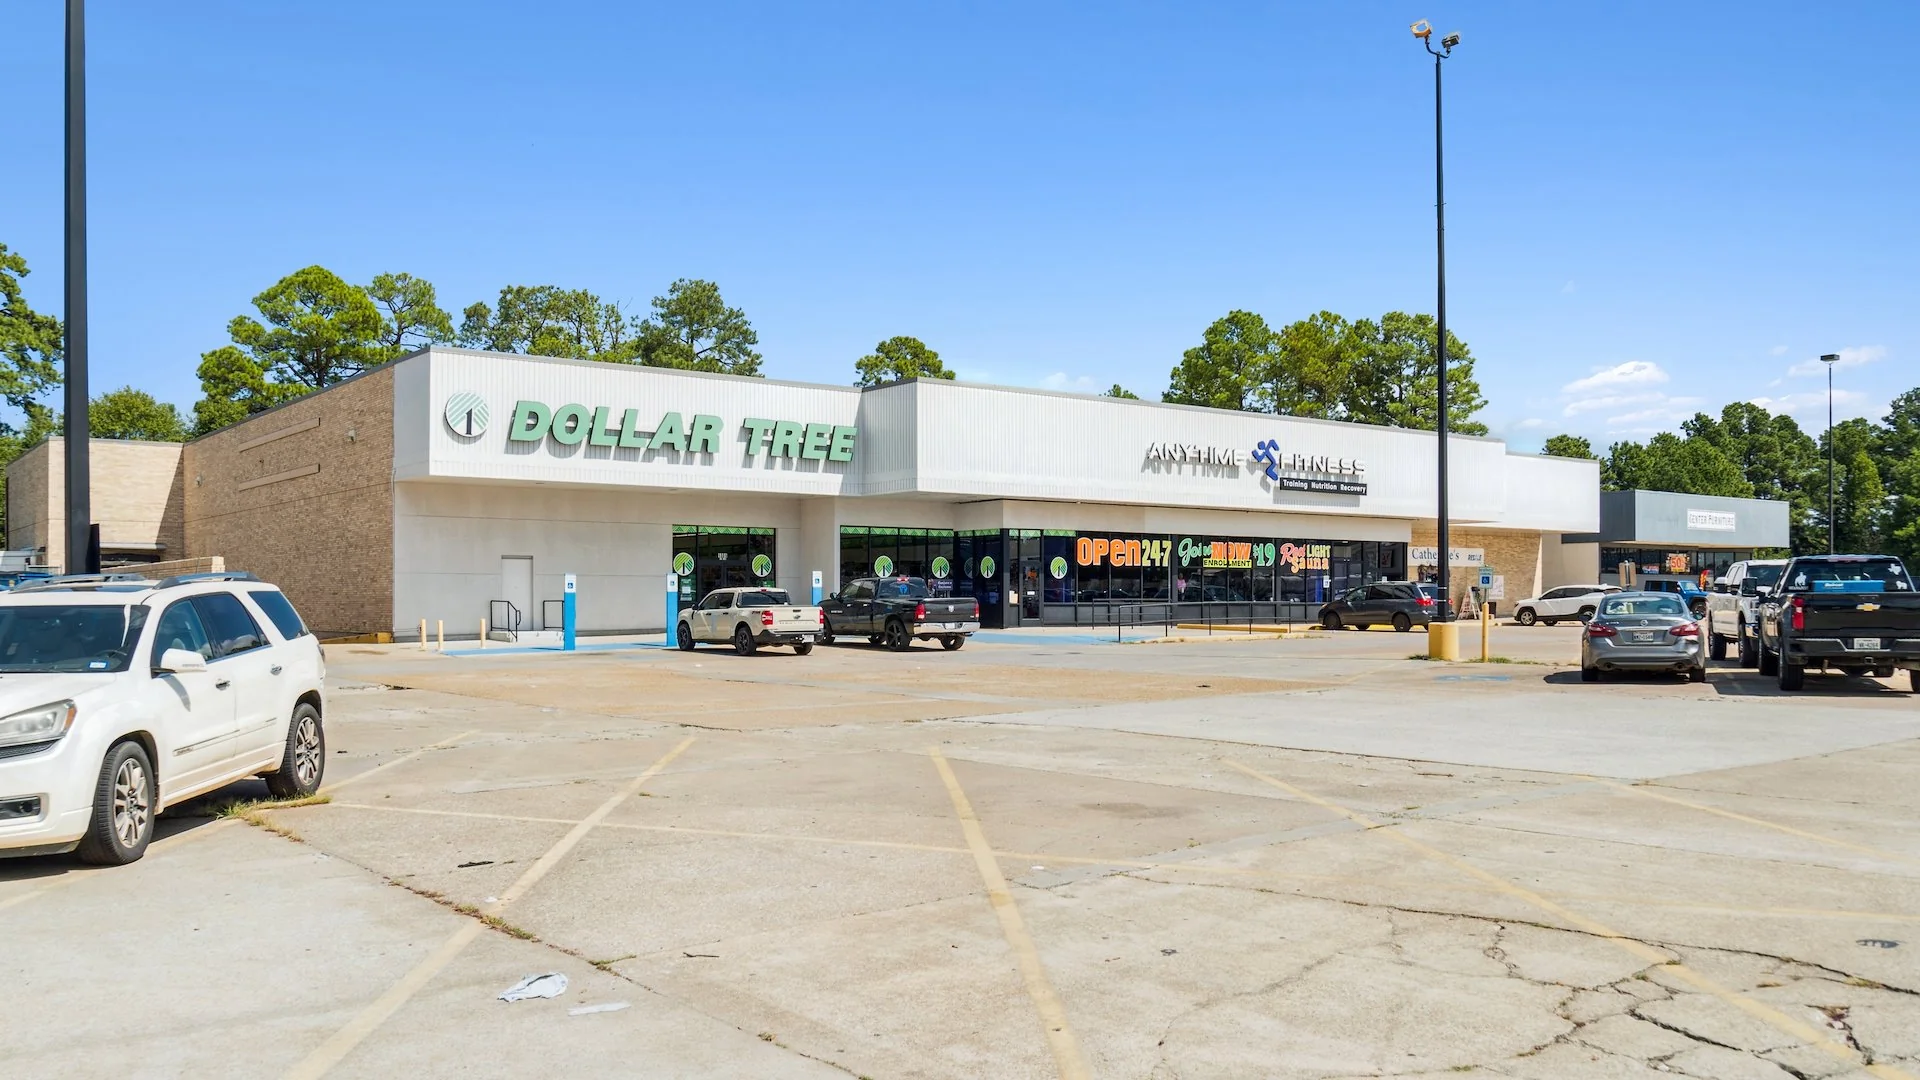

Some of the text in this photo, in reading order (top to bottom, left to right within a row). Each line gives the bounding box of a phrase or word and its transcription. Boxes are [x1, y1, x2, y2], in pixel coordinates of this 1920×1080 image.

[509, 400, 858, 462] DOLLAR TREE
[1147, 442, 1368, 475] ANYTIME FITNESS
[1282, 479, 1367, 494] Training Nutrition Recovery
[1210, 541, 1252, 560] NOW
[1253, 543, 1276, 566] $19
[1306, 544, 1331, 558] LIGHT
[1411, 547, 1460, 560] Cathee's
[1203, 559, 1251, 567] ENROLLMENT
[1291, 556, 1330, 573] Sauna
